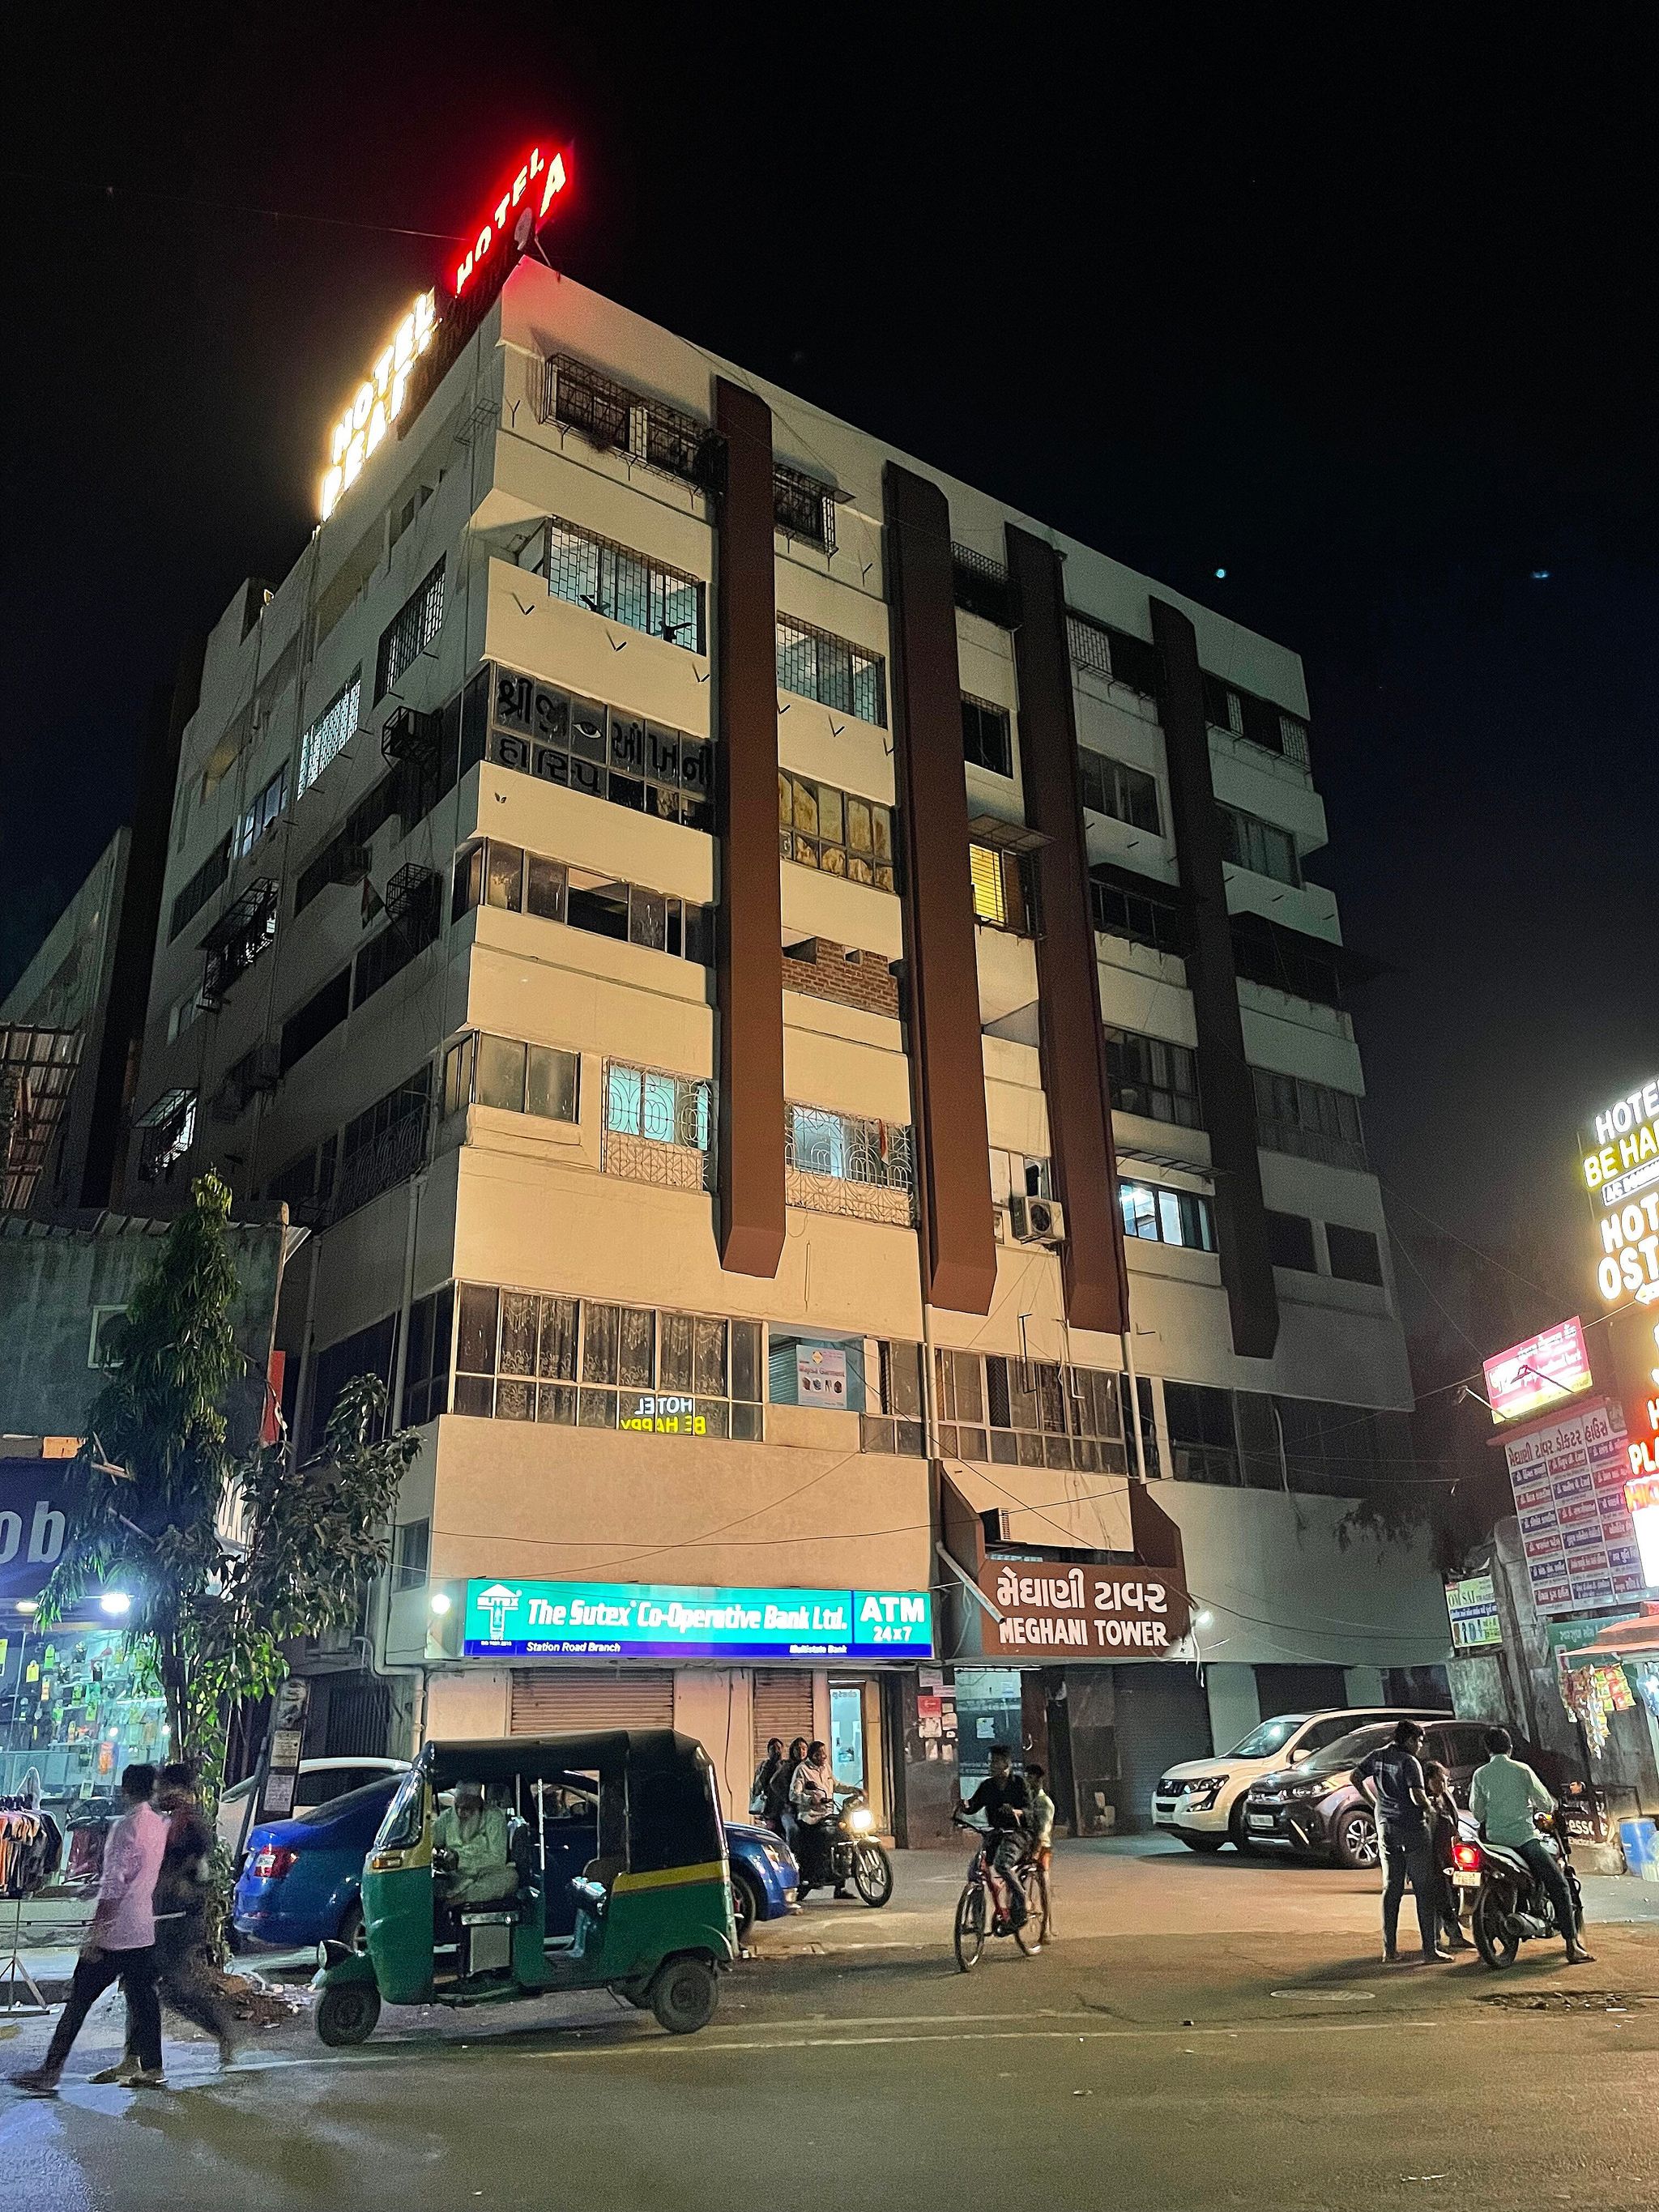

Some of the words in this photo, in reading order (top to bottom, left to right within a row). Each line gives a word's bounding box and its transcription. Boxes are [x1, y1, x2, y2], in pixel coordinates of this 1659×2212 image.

[456, 147, 544, 296] HOTEL
[1594, 1078, 1659, 1145] HOTE
[1584, 1146, 1618, 1188] BE
[1597, 1234, 1659, 1300] OST
[996, 1566, 1085, 1609] મેઘાણી
[1094, 1581, 1168, 1613] ટાવર
[528, 1598, 567, 1626] The
[569, 1599, 629, 1627] Sutex
[637, 1601, 762, 1634] Co-Operative
[763, 1605, 810, 1630] Bank
[812, 1605, 848, 1630] Ltd.
[859, 1596, 925, 1623] ATM
[527, 1641, 561, 1652] Station
[562, 1642, 586, 1652] Road
[588, 1642, 621, 1653] Branch
[872, 1625, 913, 1643] 24x7
[1000, 1617, 1089, 1646] MEGHANI
[1094, 1619, 1171, 1647] TOWER
